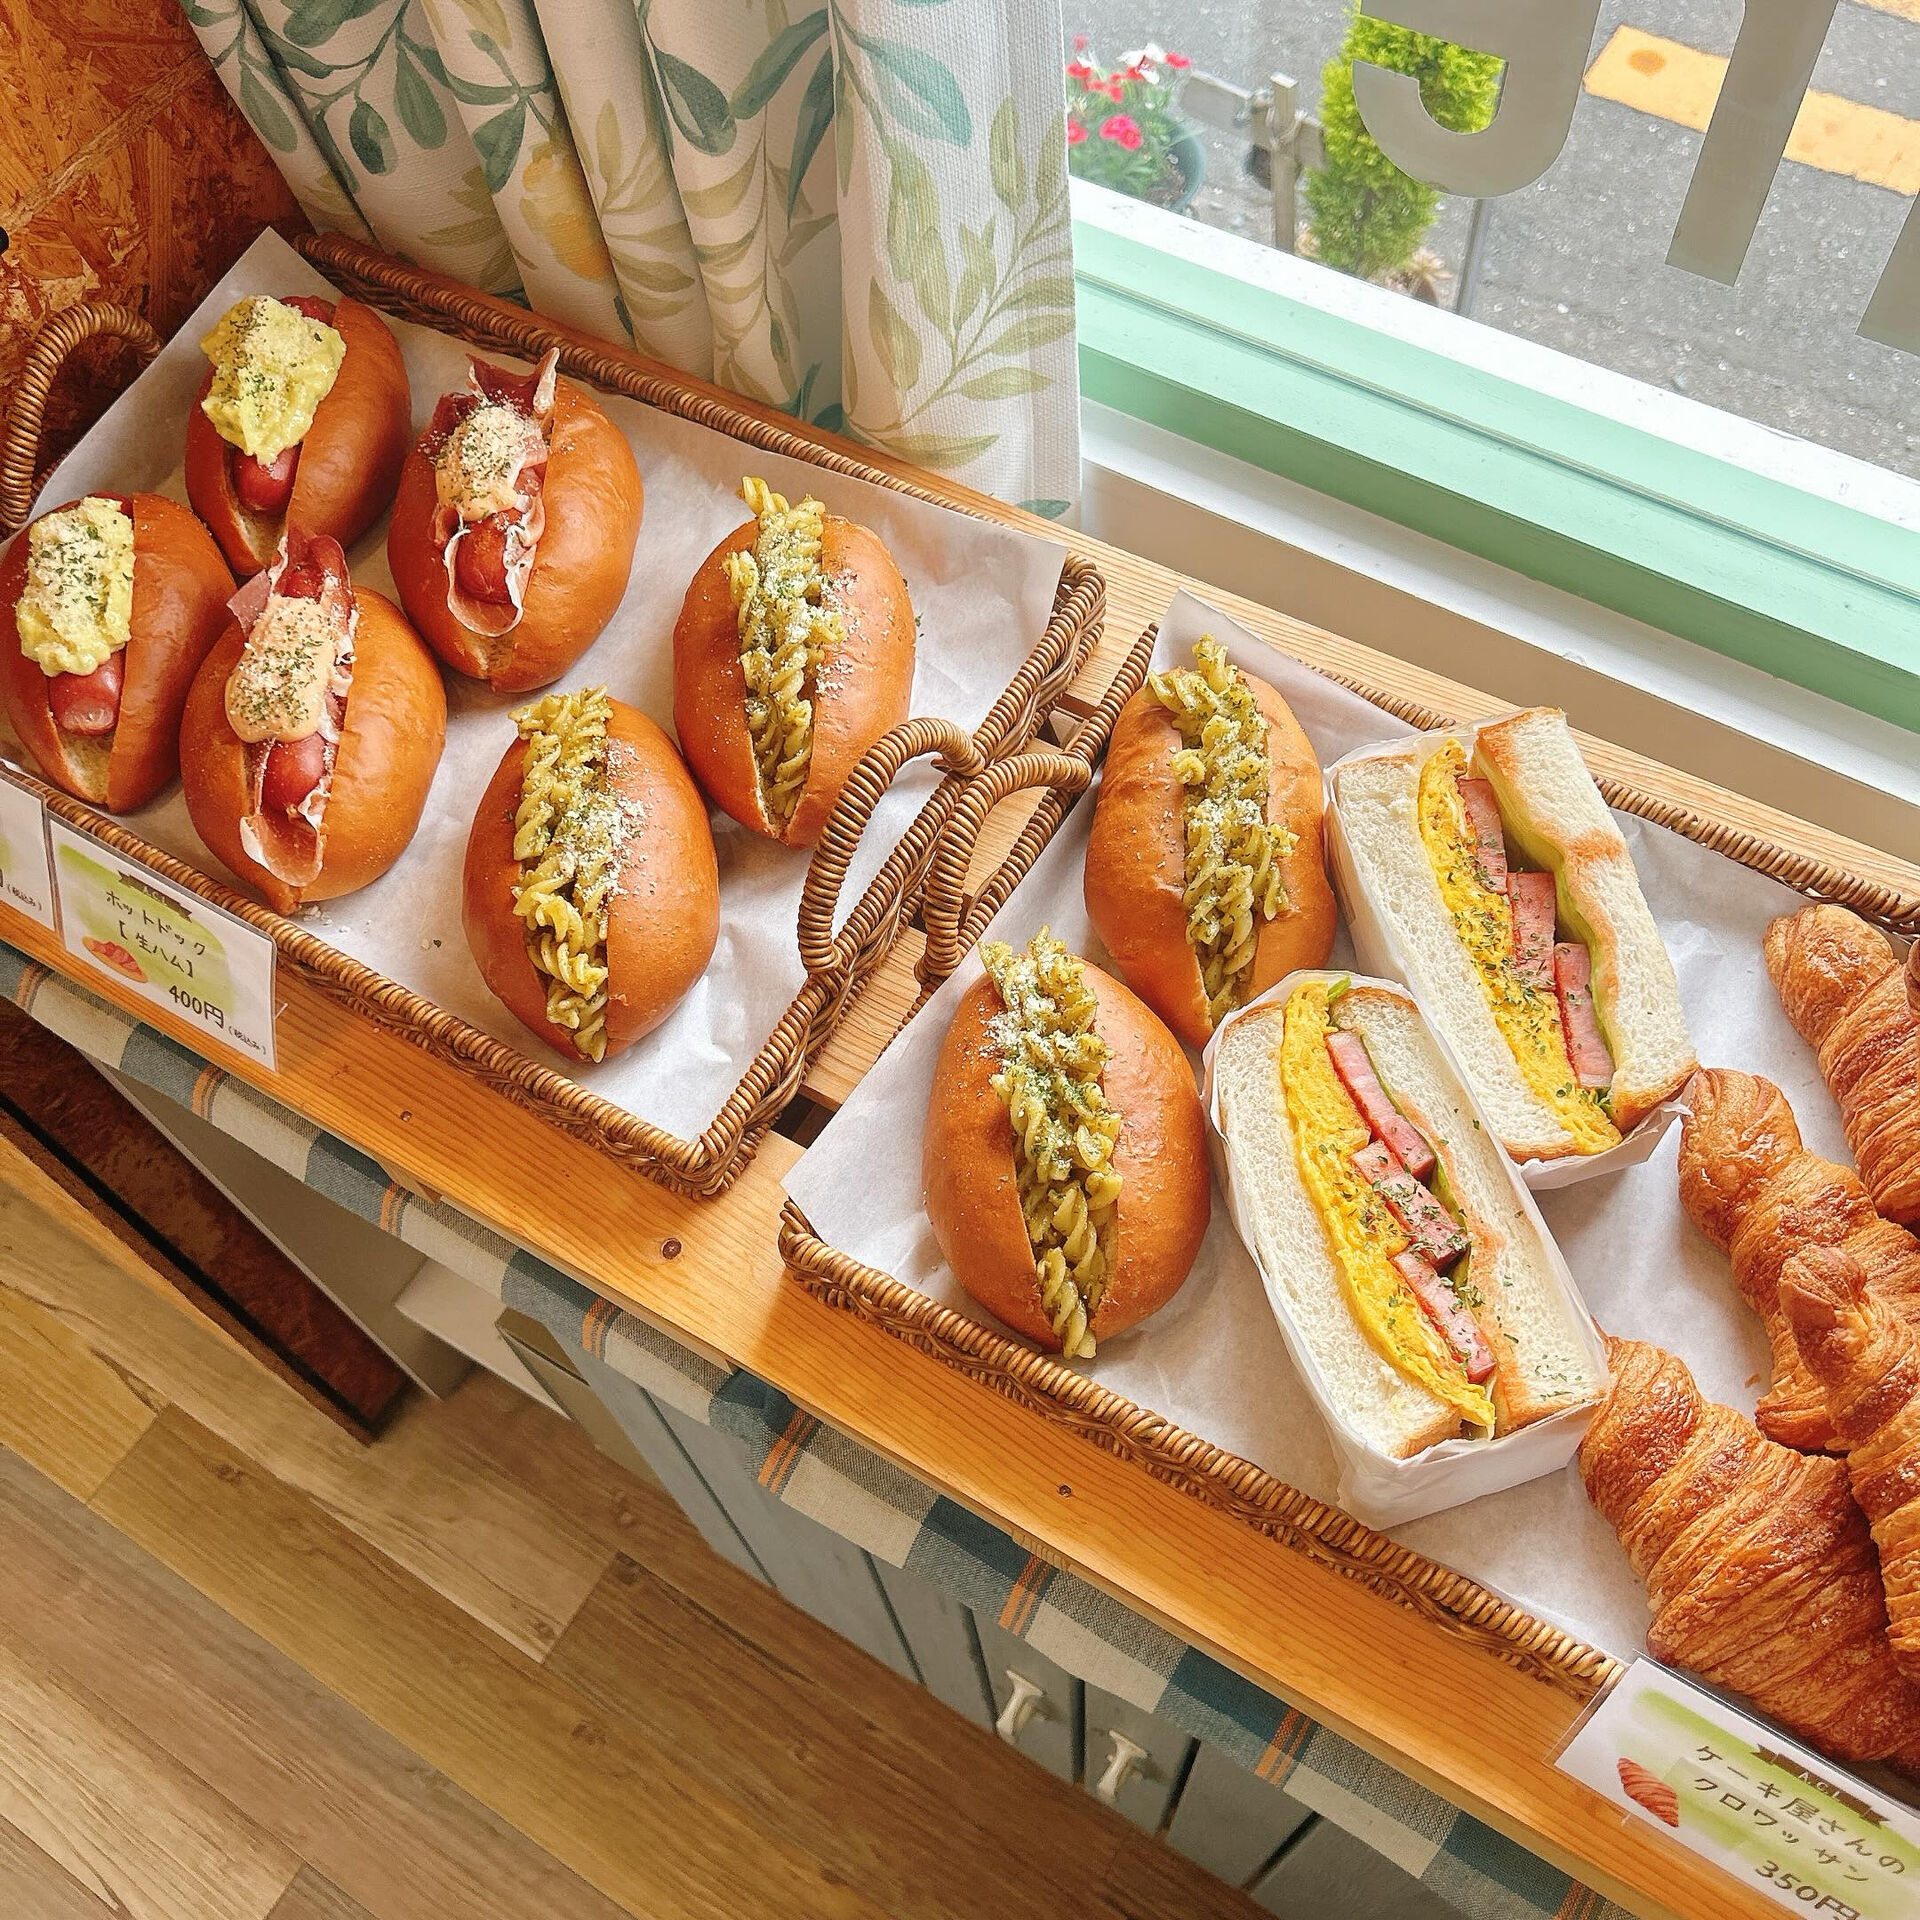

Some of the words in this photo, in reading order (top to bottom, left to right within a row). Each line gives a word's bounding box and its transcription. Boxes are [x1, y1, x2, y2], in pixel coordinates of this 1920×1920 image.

[169, 984, 224, 1029] 400円
[1694, 1778, 1869, 1882] クロワッサン
[1696, 1745, 1905, 1875] ケーキ屋さんの
[1755, 1859, 1861, 1920] 350円
